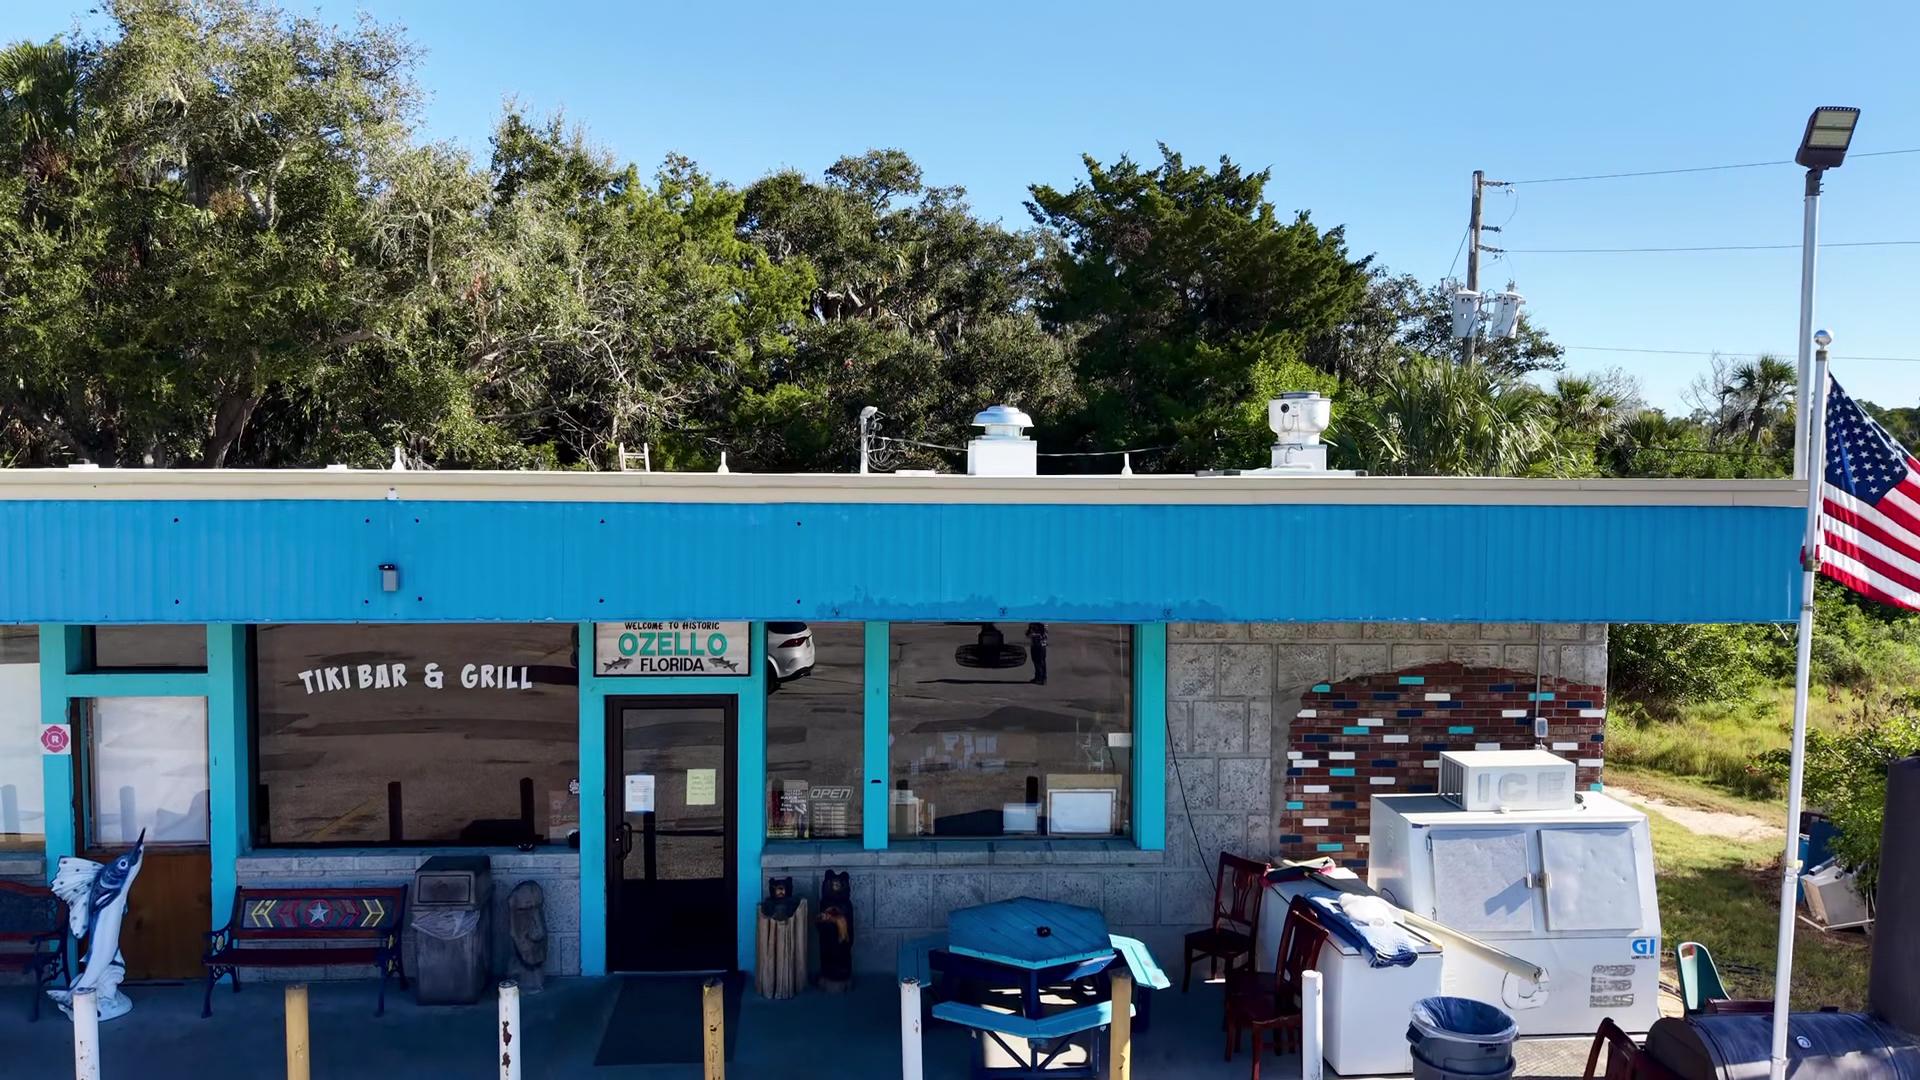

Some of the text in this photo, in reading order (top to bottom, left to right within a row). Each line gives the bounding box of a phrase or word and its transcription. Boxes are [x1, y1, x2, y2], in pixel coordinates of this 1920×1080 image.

[624, 621, 720, 630] WELCOME TO HISTORIC
[618, 631, 728, 657] OZELLO
[640, 657, 705, 672] FLORIDA
[298, 662, 533, 695] TIKI BAR & GRILL
[51, 735, 60, 744] R
[810, 788, 851, 799] OPEN
[1478, 771, 1567, 803] ICE
[1631, 938, 1656, 955] GI
